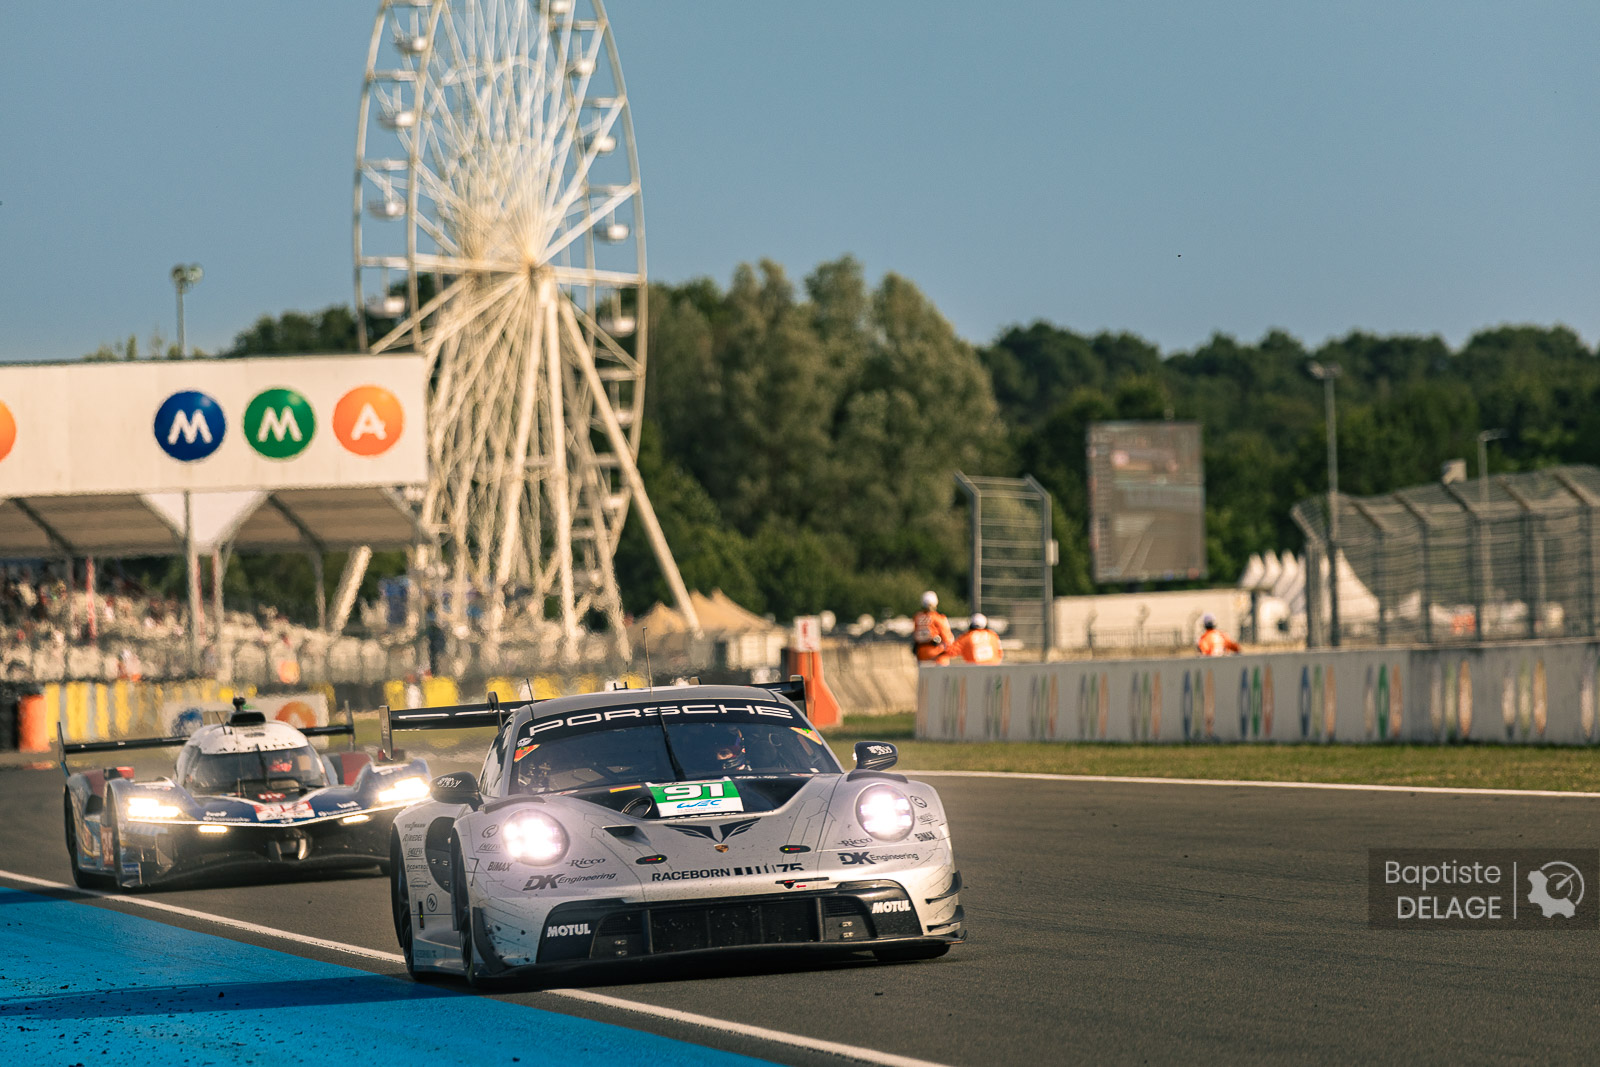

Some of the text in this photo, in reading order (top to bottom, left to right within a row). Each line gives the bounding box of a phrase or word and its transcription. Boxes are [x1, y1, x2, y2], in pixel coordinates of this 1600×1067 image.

[529, 704, 794, 737] PORSCHE
[663, 783, 725, 801] 91
[841, 837, 873, 848] Ricco
[569, 858, 606, 869] Ricco
[837, 852, 920, 865] DK Engineering
[522, 872, 617, 891] DK Engineering
[651, 867, 731, 882] RACEBORN
[871, 899, 911, 914] MOTUL
[546, 923, 592, 938] MOTUL
